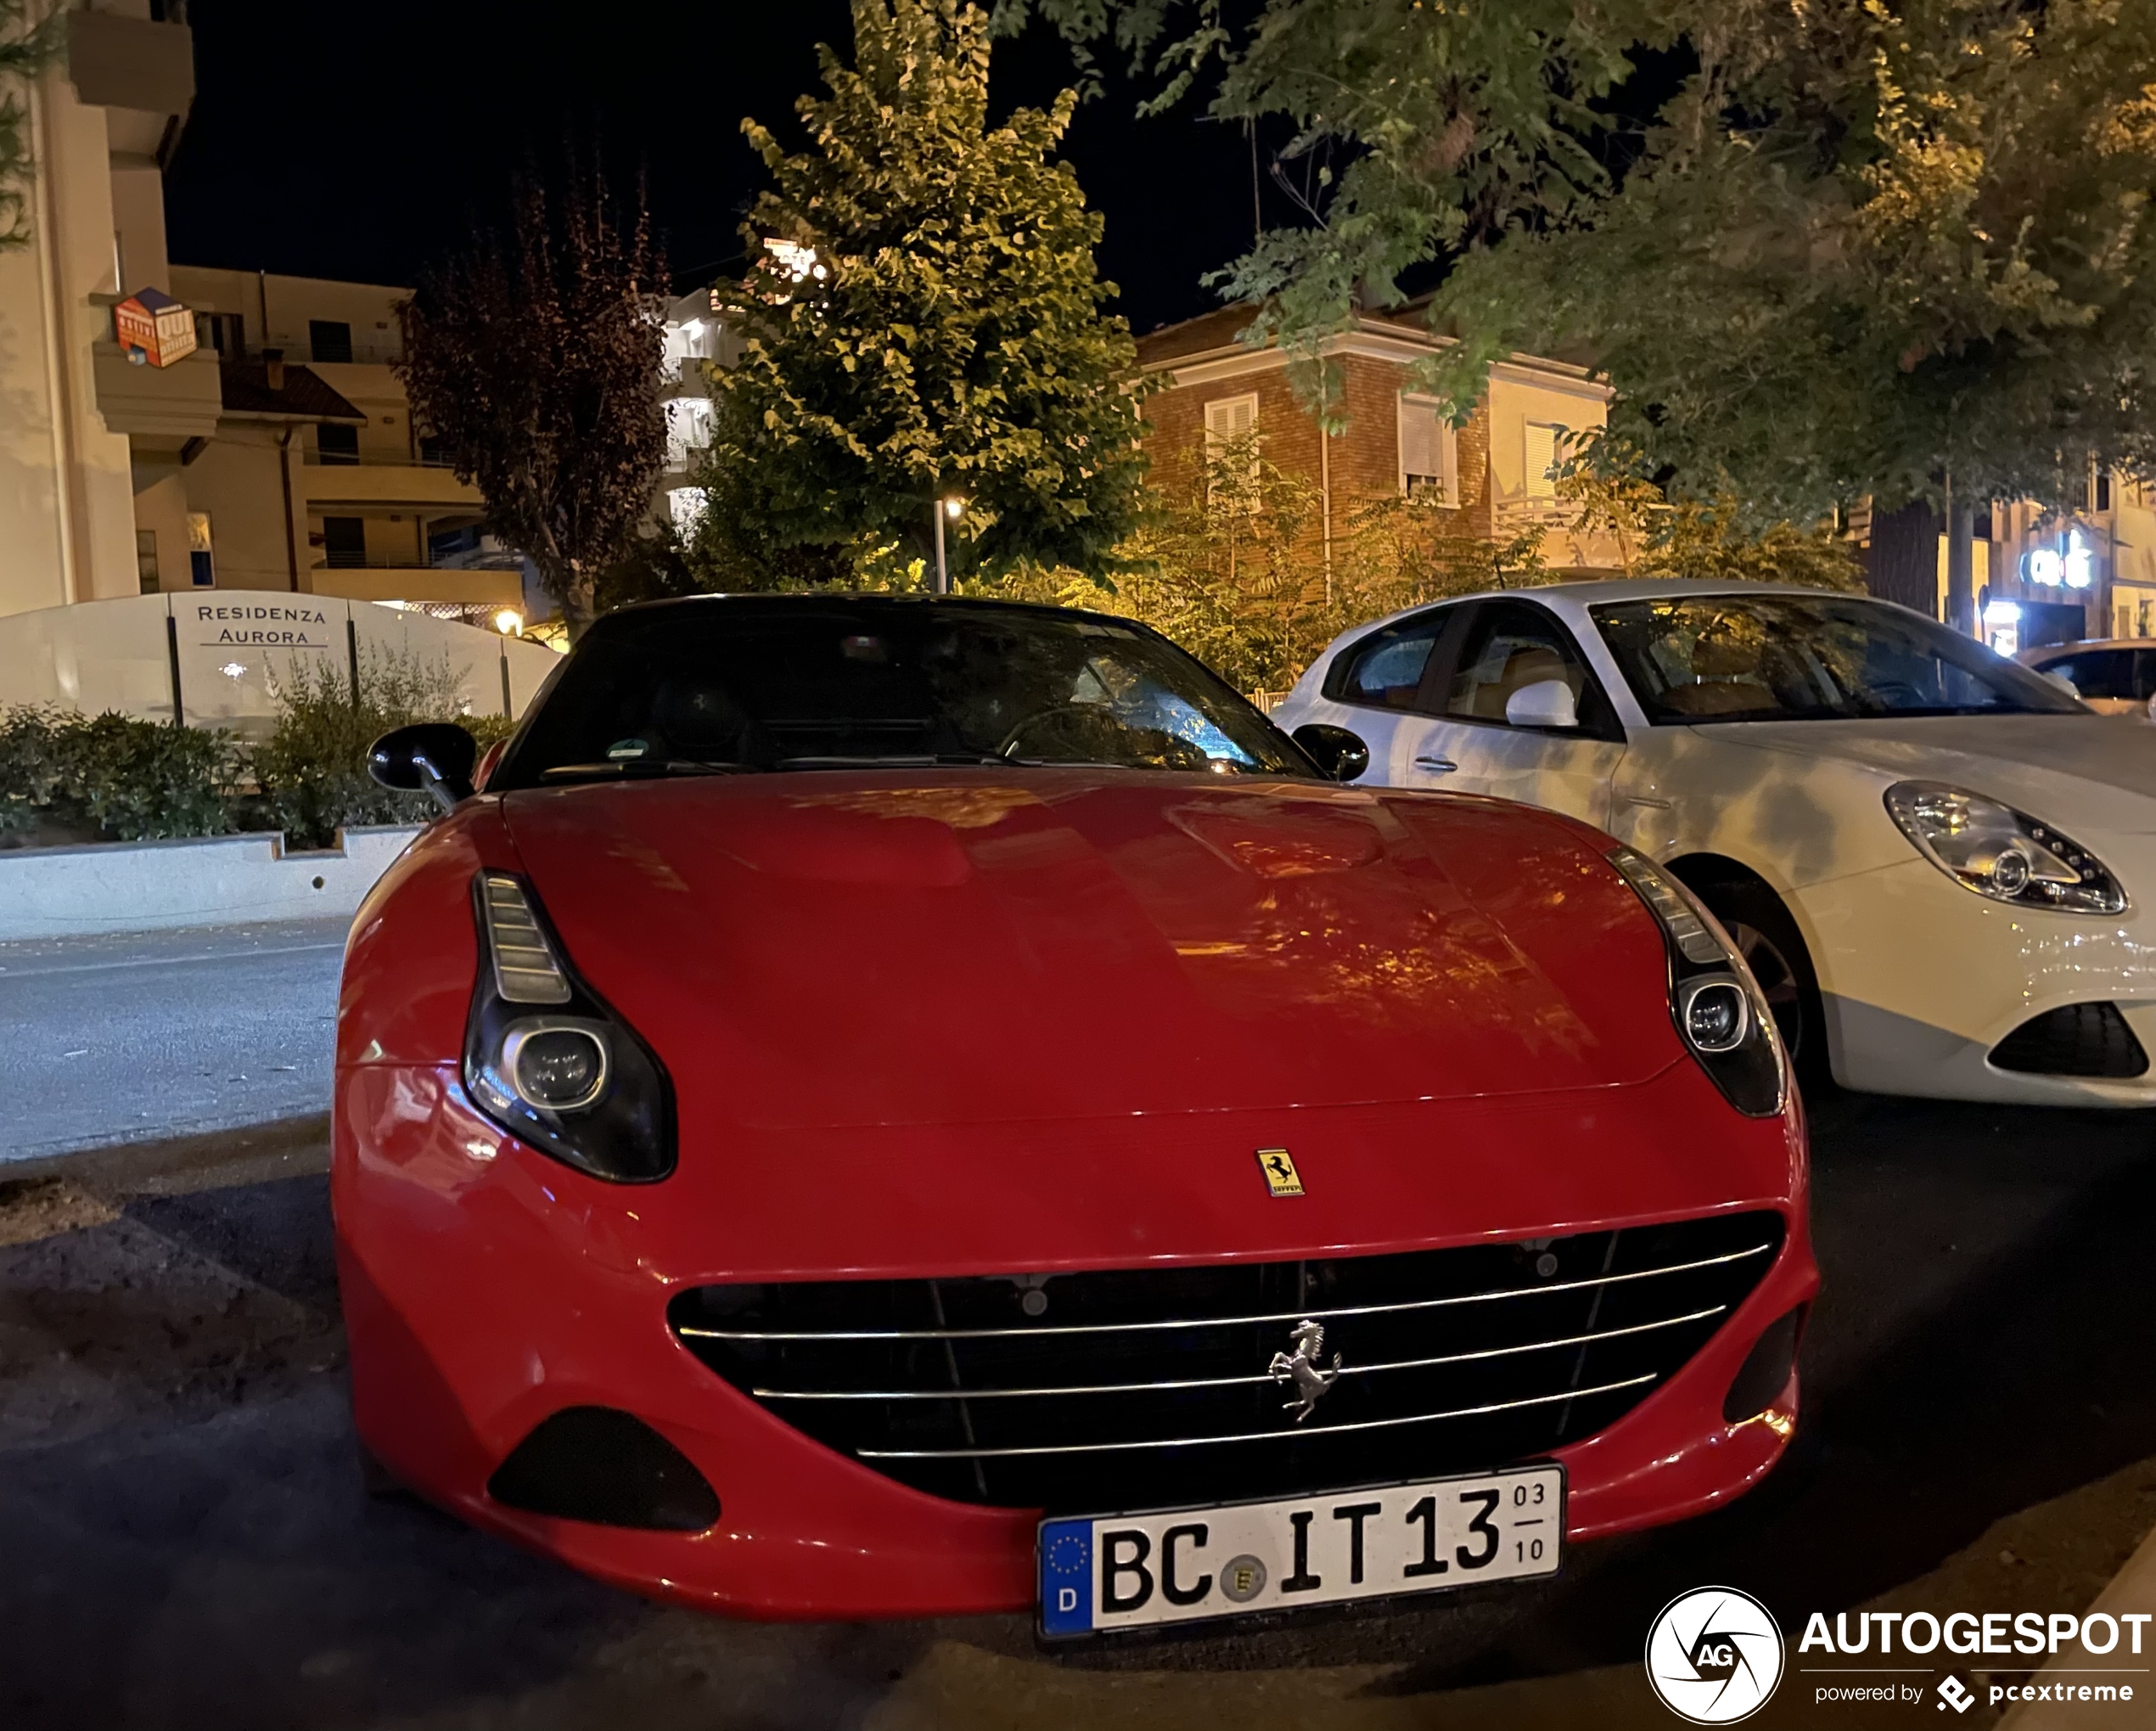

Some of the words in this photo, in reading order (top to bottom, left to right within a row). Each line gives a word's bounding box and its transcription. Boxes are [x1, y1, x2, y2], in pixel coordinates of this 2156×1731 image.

[198, 606, 325, 624] RESIDENZA
[219, 628, 308, 644] AURORA
[1513, 1483, 1544, 1506] 03
[1102, 1523, 1212, 1613] BC
[1281, 1502, 1381, 1593] IT
[1404, 1489, 1499, 1577] 13
[1516, 1538, 1543, 1562] 10
[1059, 1588, 1076, 1611] D
